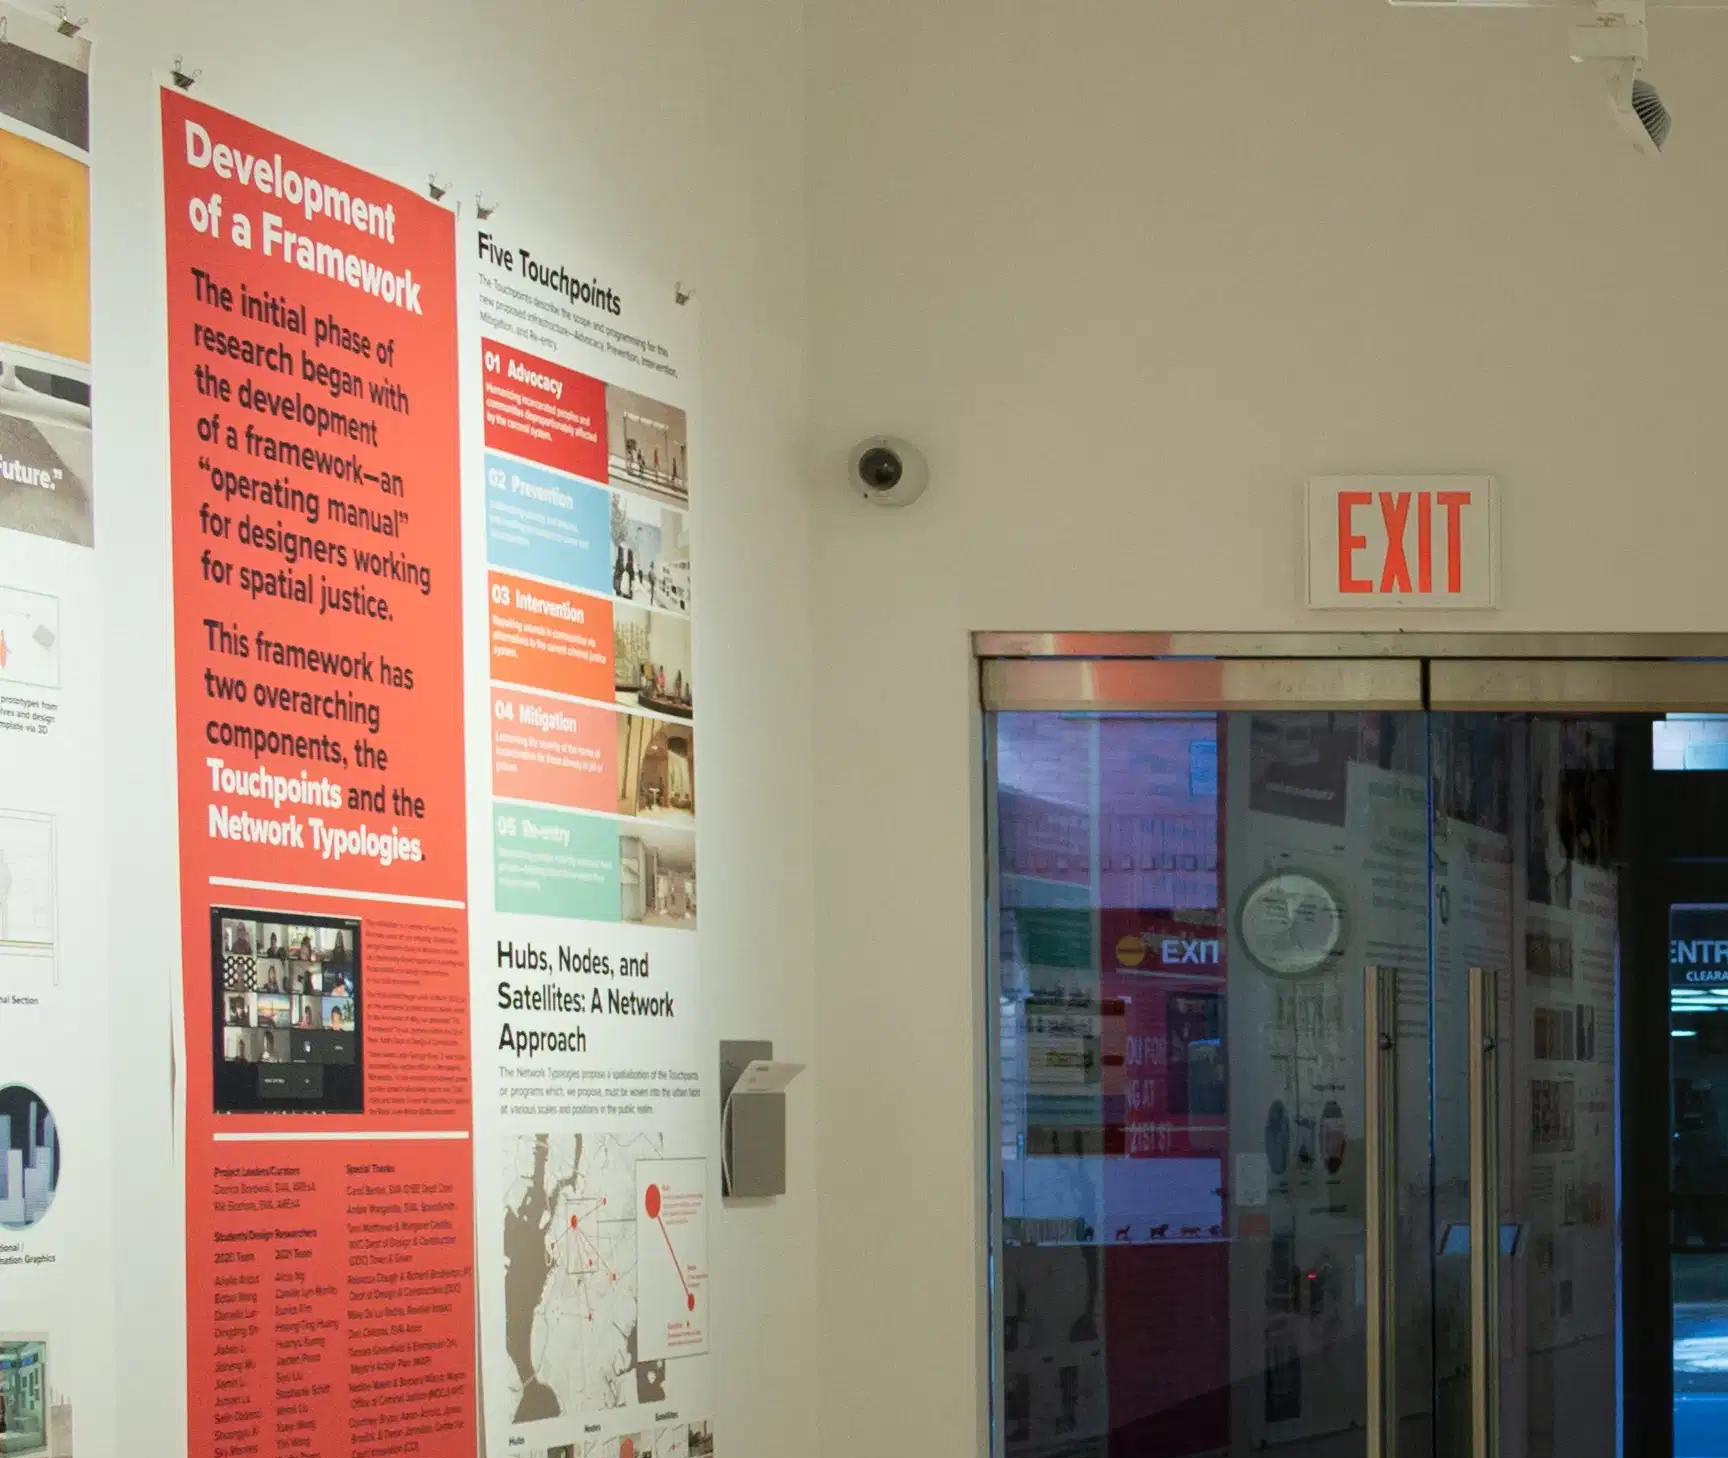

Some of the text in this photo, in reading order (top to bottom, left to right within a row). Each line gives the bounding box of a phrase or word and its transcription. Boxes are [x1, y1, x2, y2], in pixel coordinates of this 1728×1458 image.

[185, 120, 396, 245] Development
[189, 194, 423, 316] of a Framework
[478, 232, 621, 317] Five Touchpoints
[191, 268, 395, 368] The initial phase of
[194, 323, 409, 416] research began with
[486, 352, 564, 401] 01 Advocacy
[195, 365, 378, 448] the development
[0, 452, 63, 491] uture.”
[197, 414, 404, 498] of a framework—an
[489, 468, 574, 511] 02 Prevention
[198, 457, 409, 539] “operating manual”
[1338, 491, 1471, 593] EXIT
[490, 586, 585, 626] 03 Intervention
[495, 700, 577, 740] 04 Mitigation
[207, 758, 425, 820] Touchpoints and the
[208, 804, 426, 872] Network Typologies.
[497, 941, 649, 979] Hubs, Nodes, and
[498, 982, 674, 1018] Satellites: A Network
[498, 1024, 587, 1059] Approach
